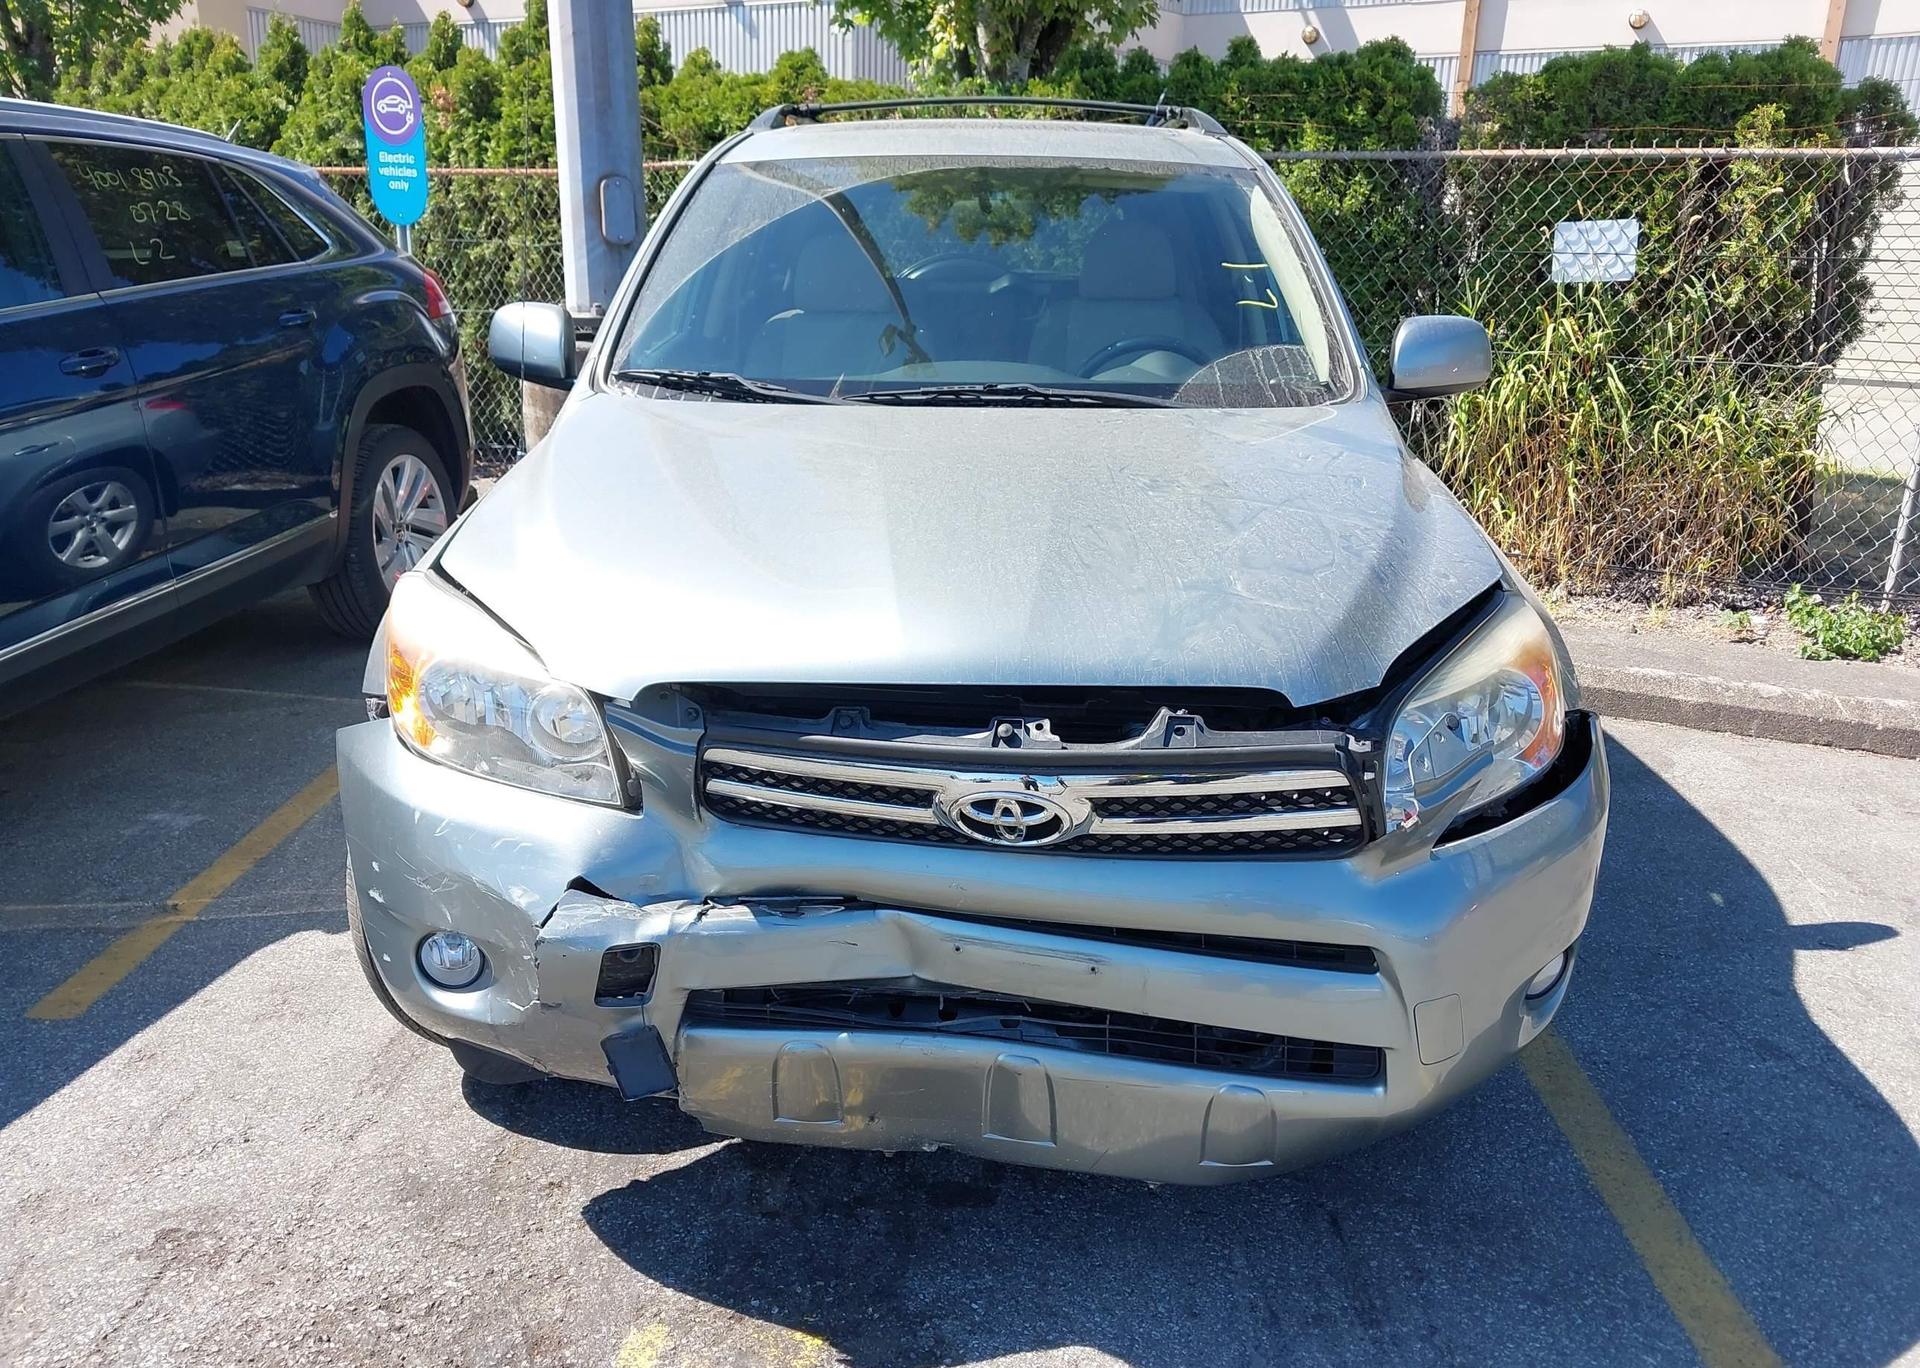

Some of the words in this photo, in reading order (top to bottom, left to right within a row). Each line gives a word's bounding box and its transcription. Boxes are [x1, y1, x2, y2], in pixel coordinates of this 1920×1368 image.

[379, 151, 415, 164] Electric
[378, 166, 417, 177] vehicles
[389, 180, 409, 192] only
